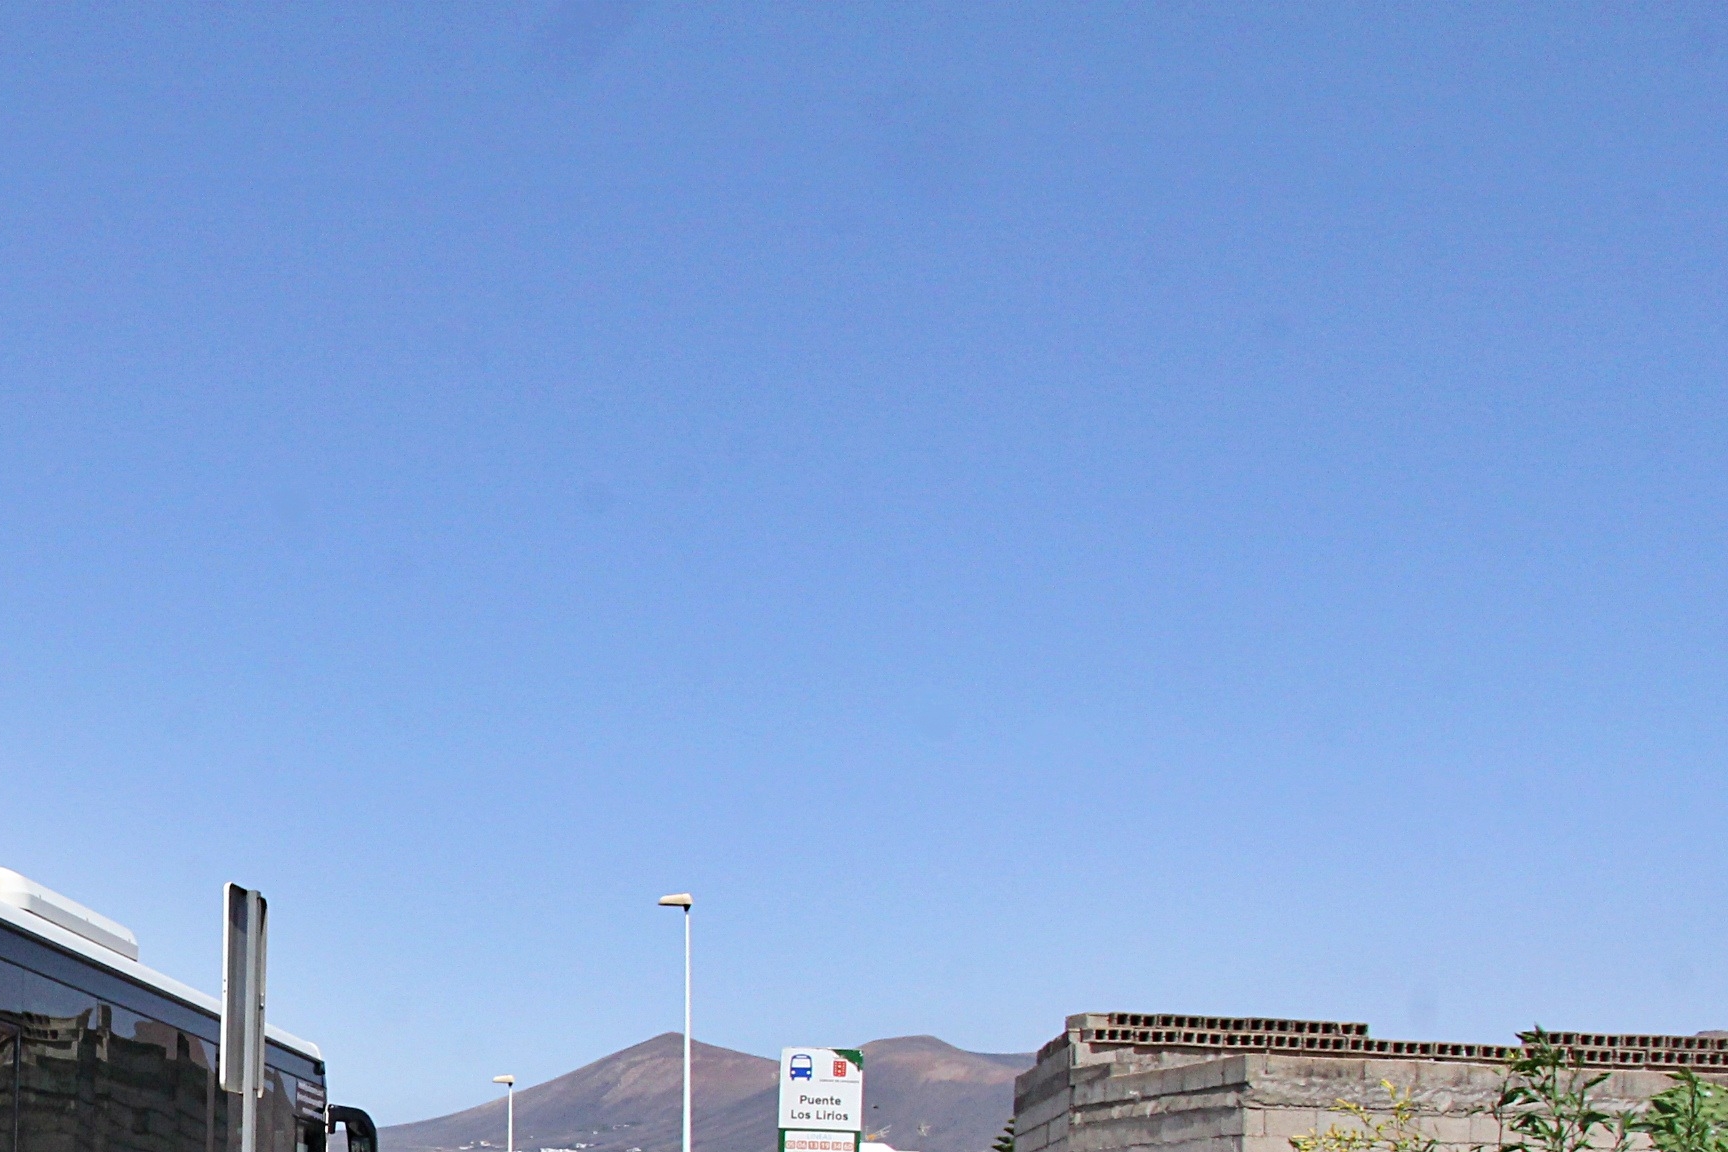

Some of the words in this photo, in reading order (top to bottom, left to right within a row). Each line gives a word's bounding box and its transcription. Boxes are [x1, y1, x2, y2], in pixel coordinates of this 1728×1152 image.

[800, 1095, 841, 1106] Puente
[791, 1110, 811, 1120] Los
[816, 1110, 849, 1121] Lirios
